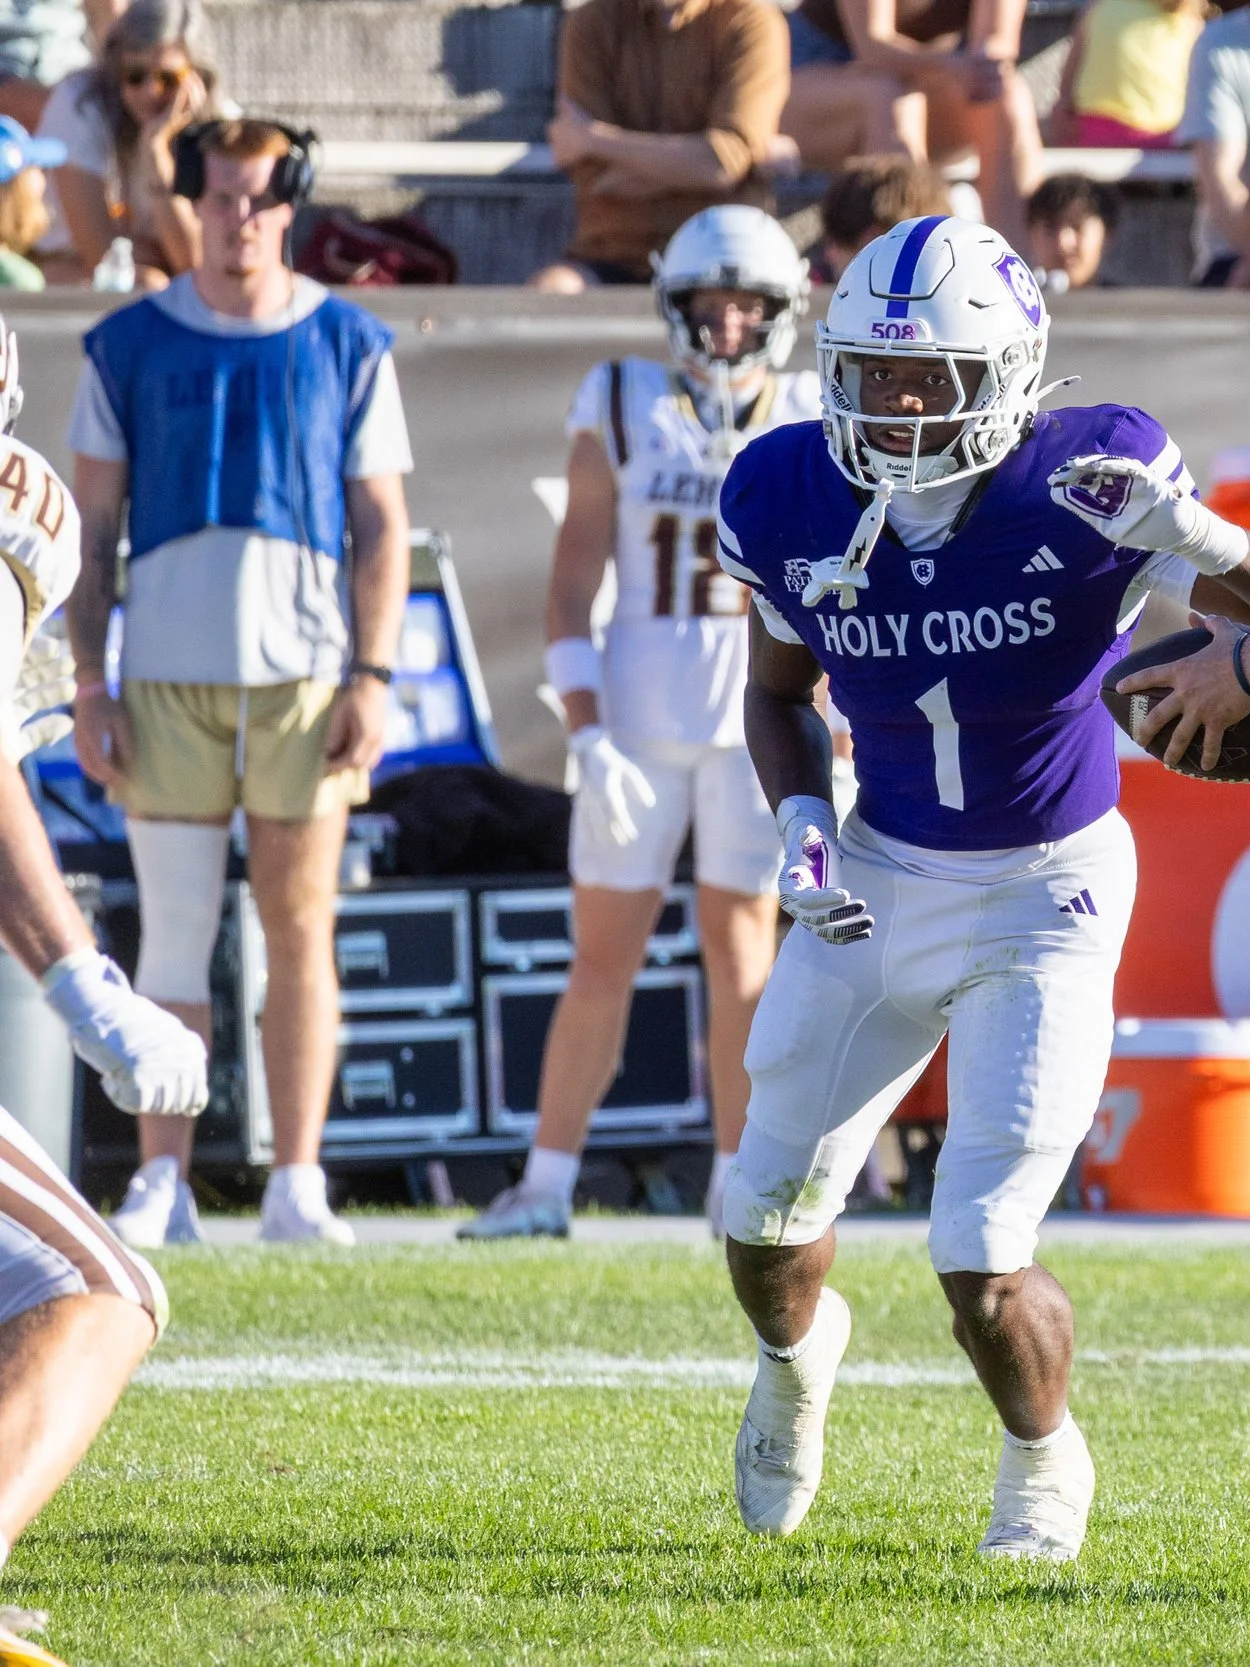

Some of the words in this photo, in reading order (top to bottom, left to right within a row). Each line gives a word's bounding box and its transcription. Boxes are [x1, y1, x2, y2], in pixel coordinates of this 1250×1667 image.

[871, 322, 915, 340] 508
[831, 384, 852, 411] ddell
[886, 462, 912, 471] Riddel
[0, 452, 64, 541] 40
[816, 613, 910, 657] HOLY
[922, 597, 1056, 655] CROSS
[915, 676, 964, 811] 1
